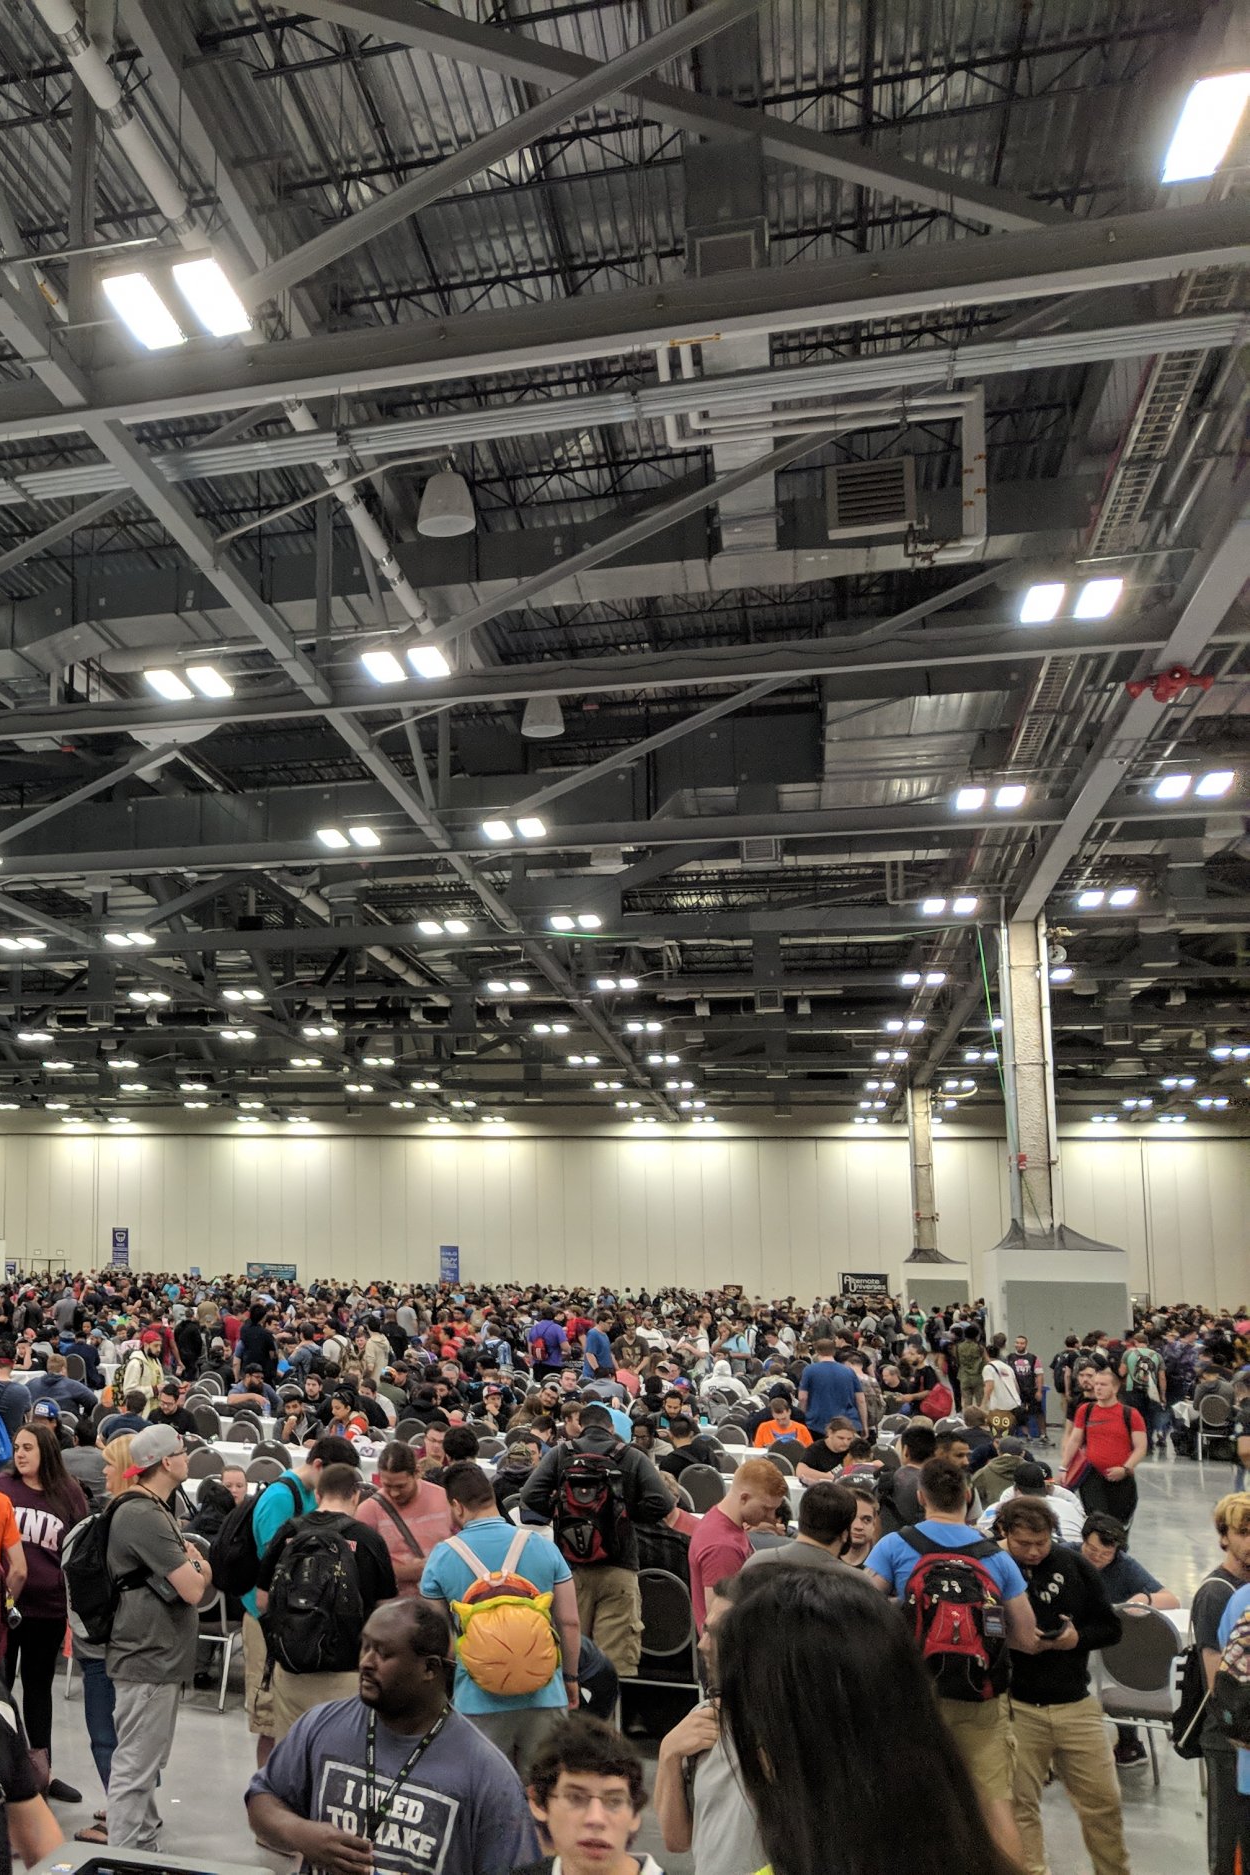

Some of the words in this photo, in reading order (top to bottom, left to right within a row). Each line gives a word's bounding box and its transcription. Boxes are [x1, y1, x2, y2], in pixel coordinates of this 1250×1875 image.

[844, 1275, 880, 1285] Alternate
[850, 1280, 886, 1292] Universes
[14, 1506, 64, 1551] INK
[343, 1779, 356, 1806] I
[326, 1805, 358, 1838] TO
